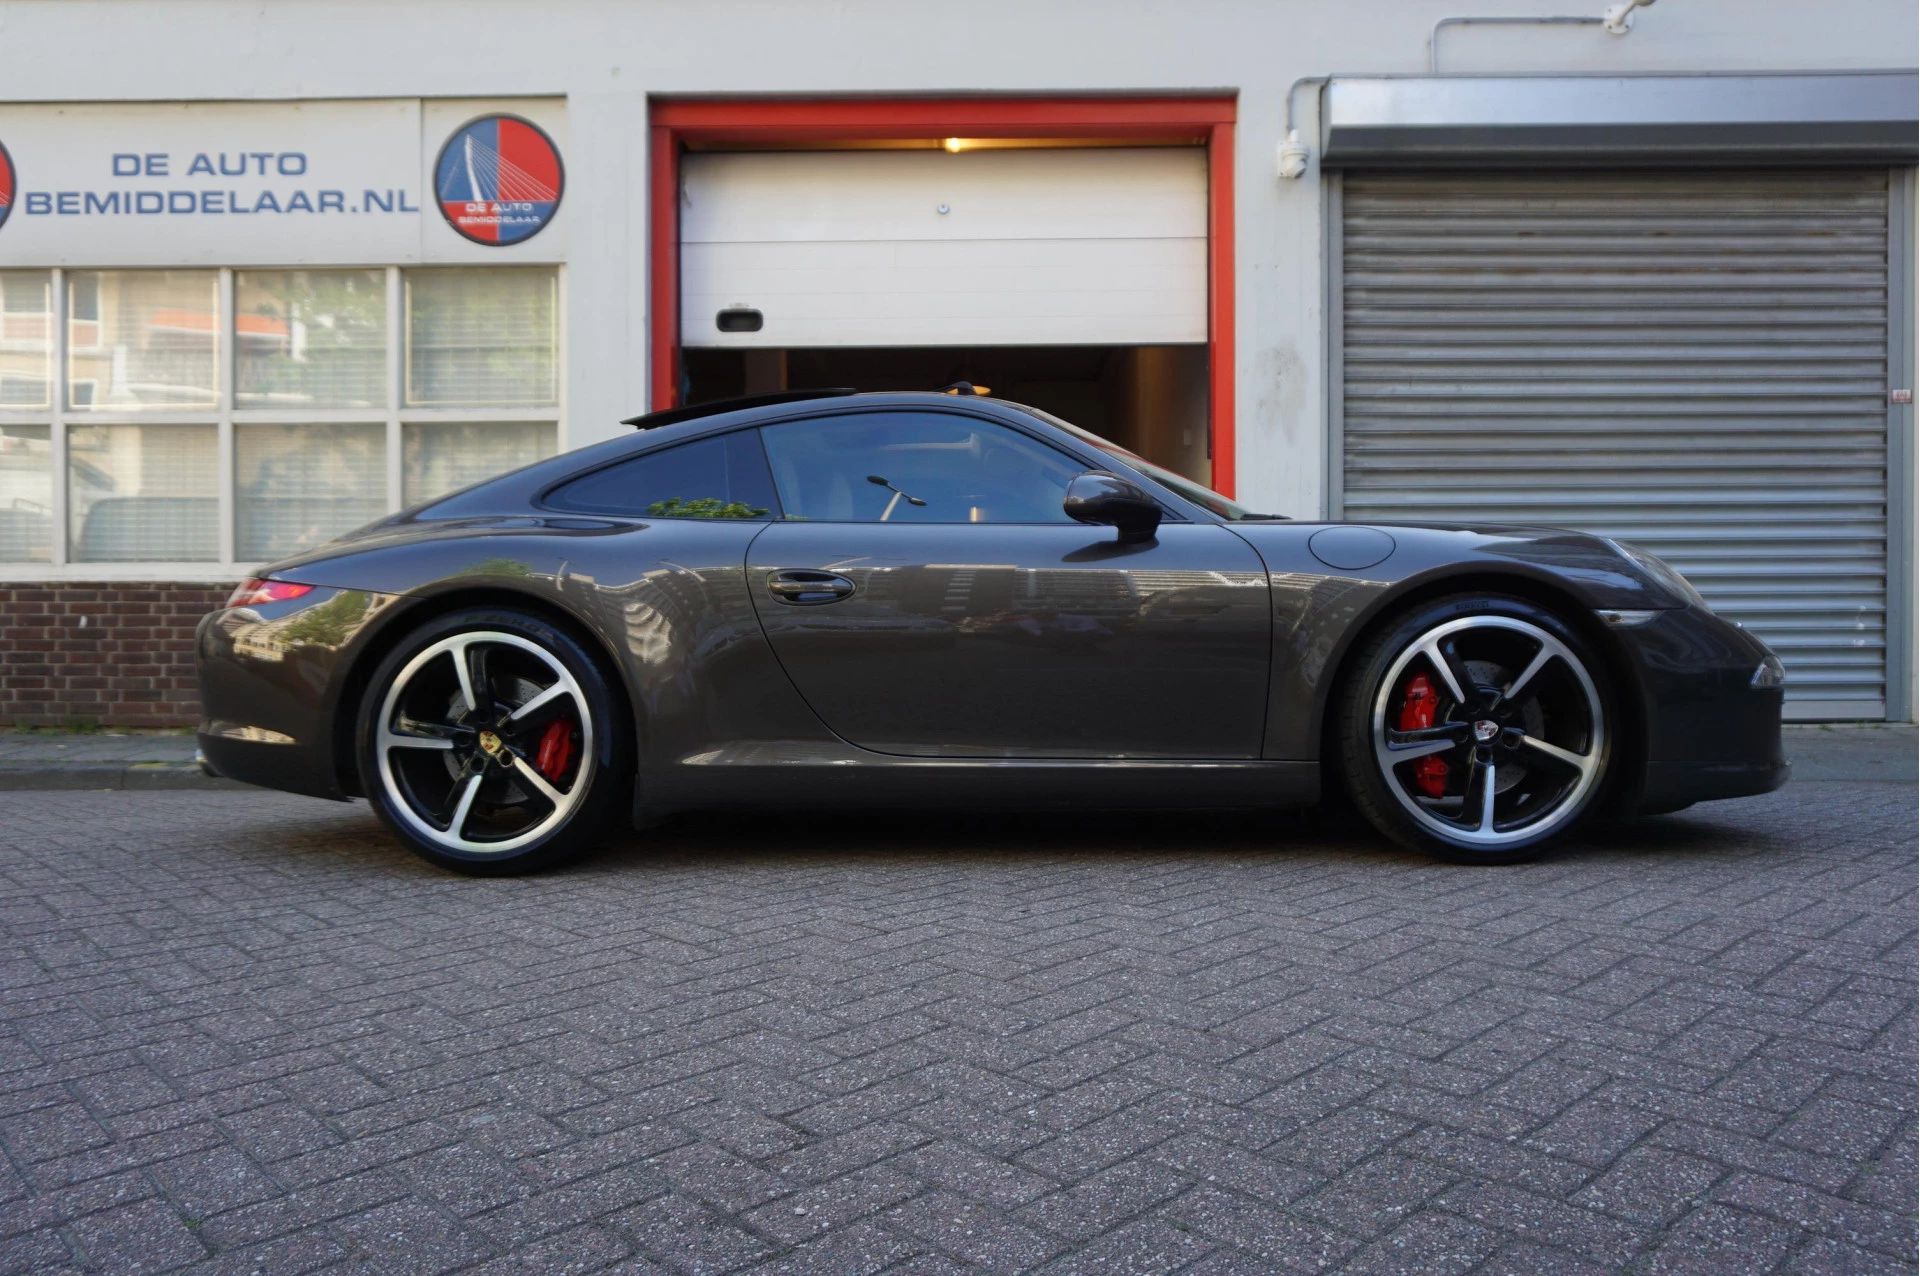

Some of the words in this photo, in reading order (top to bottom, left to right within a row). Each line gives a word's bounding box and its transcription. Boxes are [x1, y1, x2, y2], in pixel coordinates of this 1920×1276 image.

[112, 153, 169, 176] DE
[186, 152, 307, 176] AUTO
[25, 189, 420, 215] BEMIDDELAAR.NL
[465, 202, 487, 213] DE
[491, 202, 533, 212] AUTO
[458, 215, 541, 225] BEMIDDELAAR
